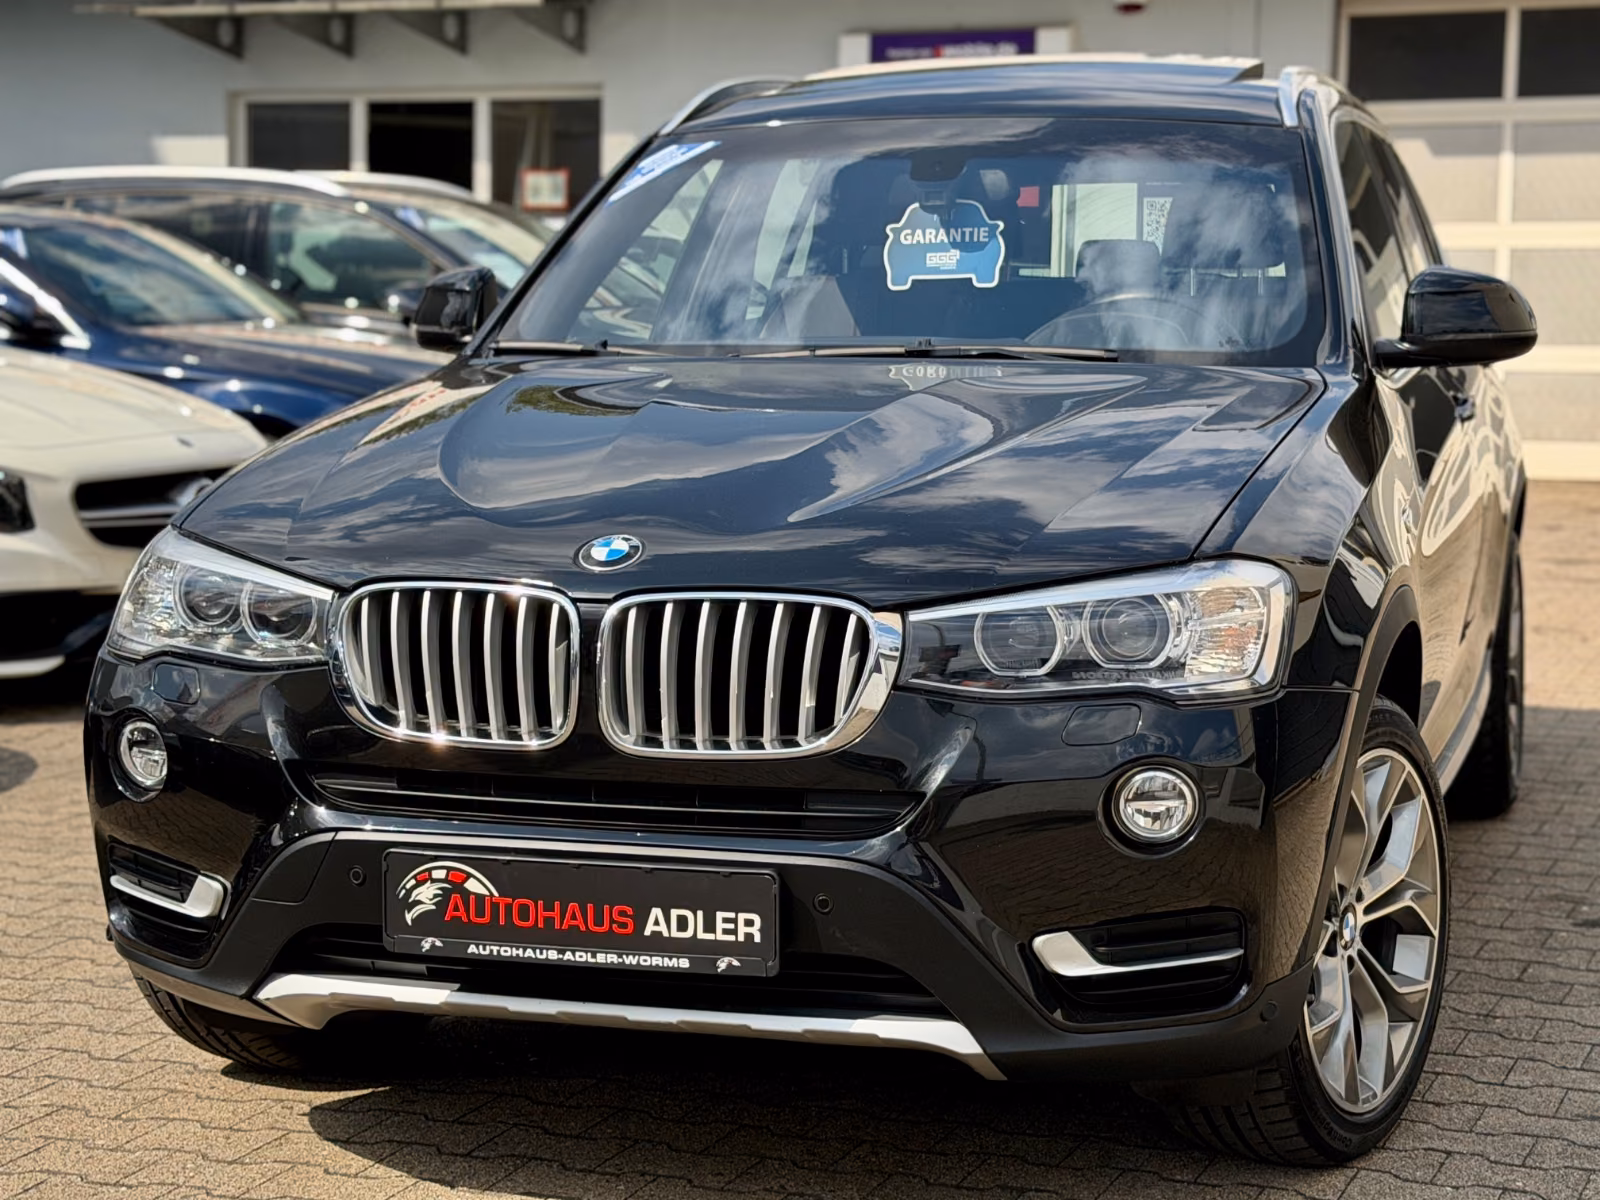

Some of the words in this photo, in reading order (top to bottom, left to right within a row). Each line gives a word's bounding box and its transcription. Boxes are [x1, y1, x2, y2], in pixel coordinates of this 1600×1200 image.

[900, 227, 989, 244] GARANTIE
[444, 893, 635, 935] AUTOHAUS
[643, 907, 762, 943] ADLER
[467, 944, 690, 968] AUTOHAUS-ADLER-WORMS
